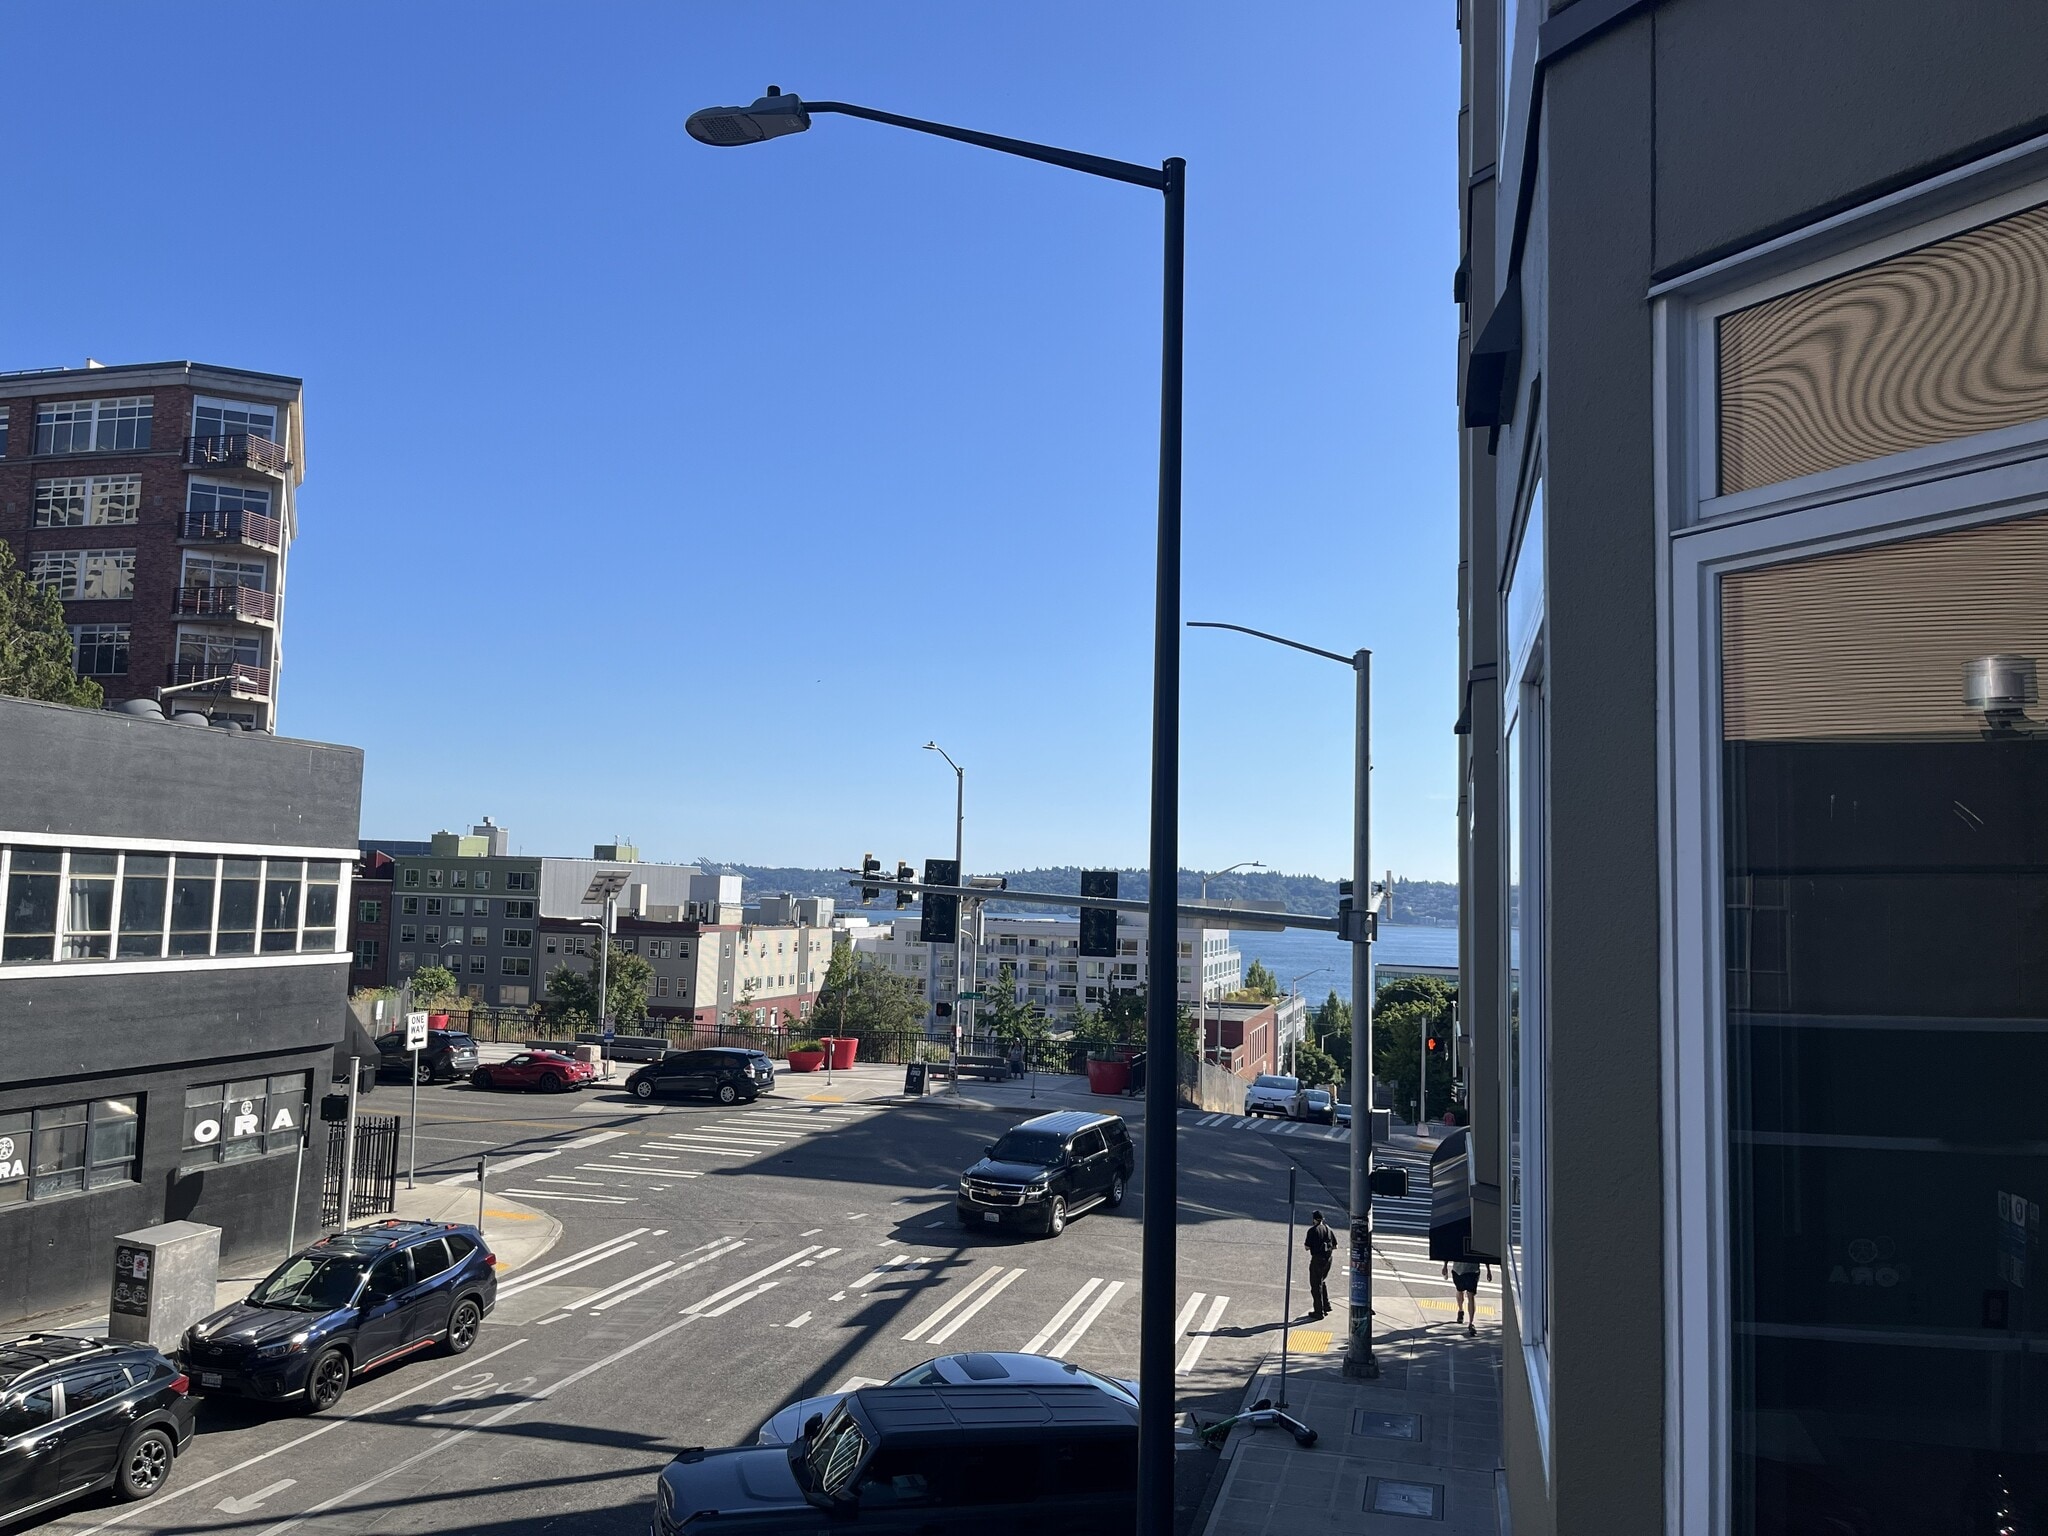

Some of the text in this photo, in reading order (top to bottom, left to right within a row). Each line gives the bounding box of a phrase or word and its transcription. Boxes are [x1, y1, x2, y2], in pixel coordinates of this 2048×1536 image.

[411, 1015, 424, 1024] ONE
[410, 1025, 425, 1034] WAY
[194, 1108, 294, 1143] ORA
